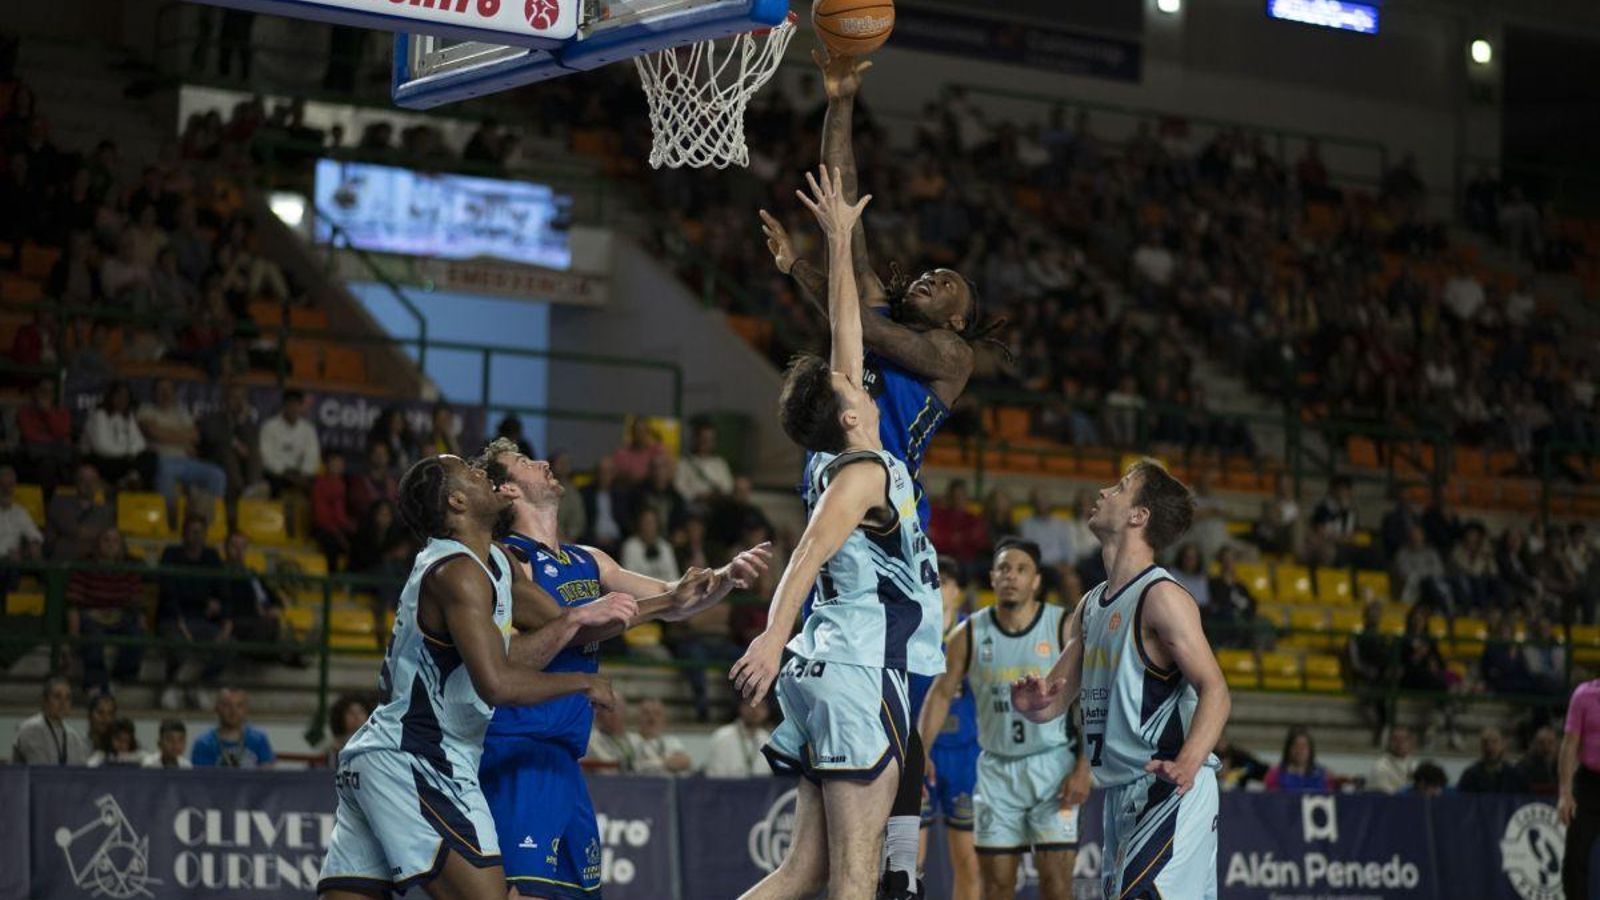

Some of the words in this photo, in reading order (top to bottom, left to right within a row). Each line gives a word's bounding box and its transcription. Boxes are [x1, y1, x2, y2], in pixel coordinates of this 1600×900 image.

[1013, 720, 1025, 743] 3
[1087, 733, 1103, 767] 7
[174, 850, 321, 890] OURENS
[1225, 851, 1300, 887] Alán
[1305, 853, 1420, 889] Penedo
